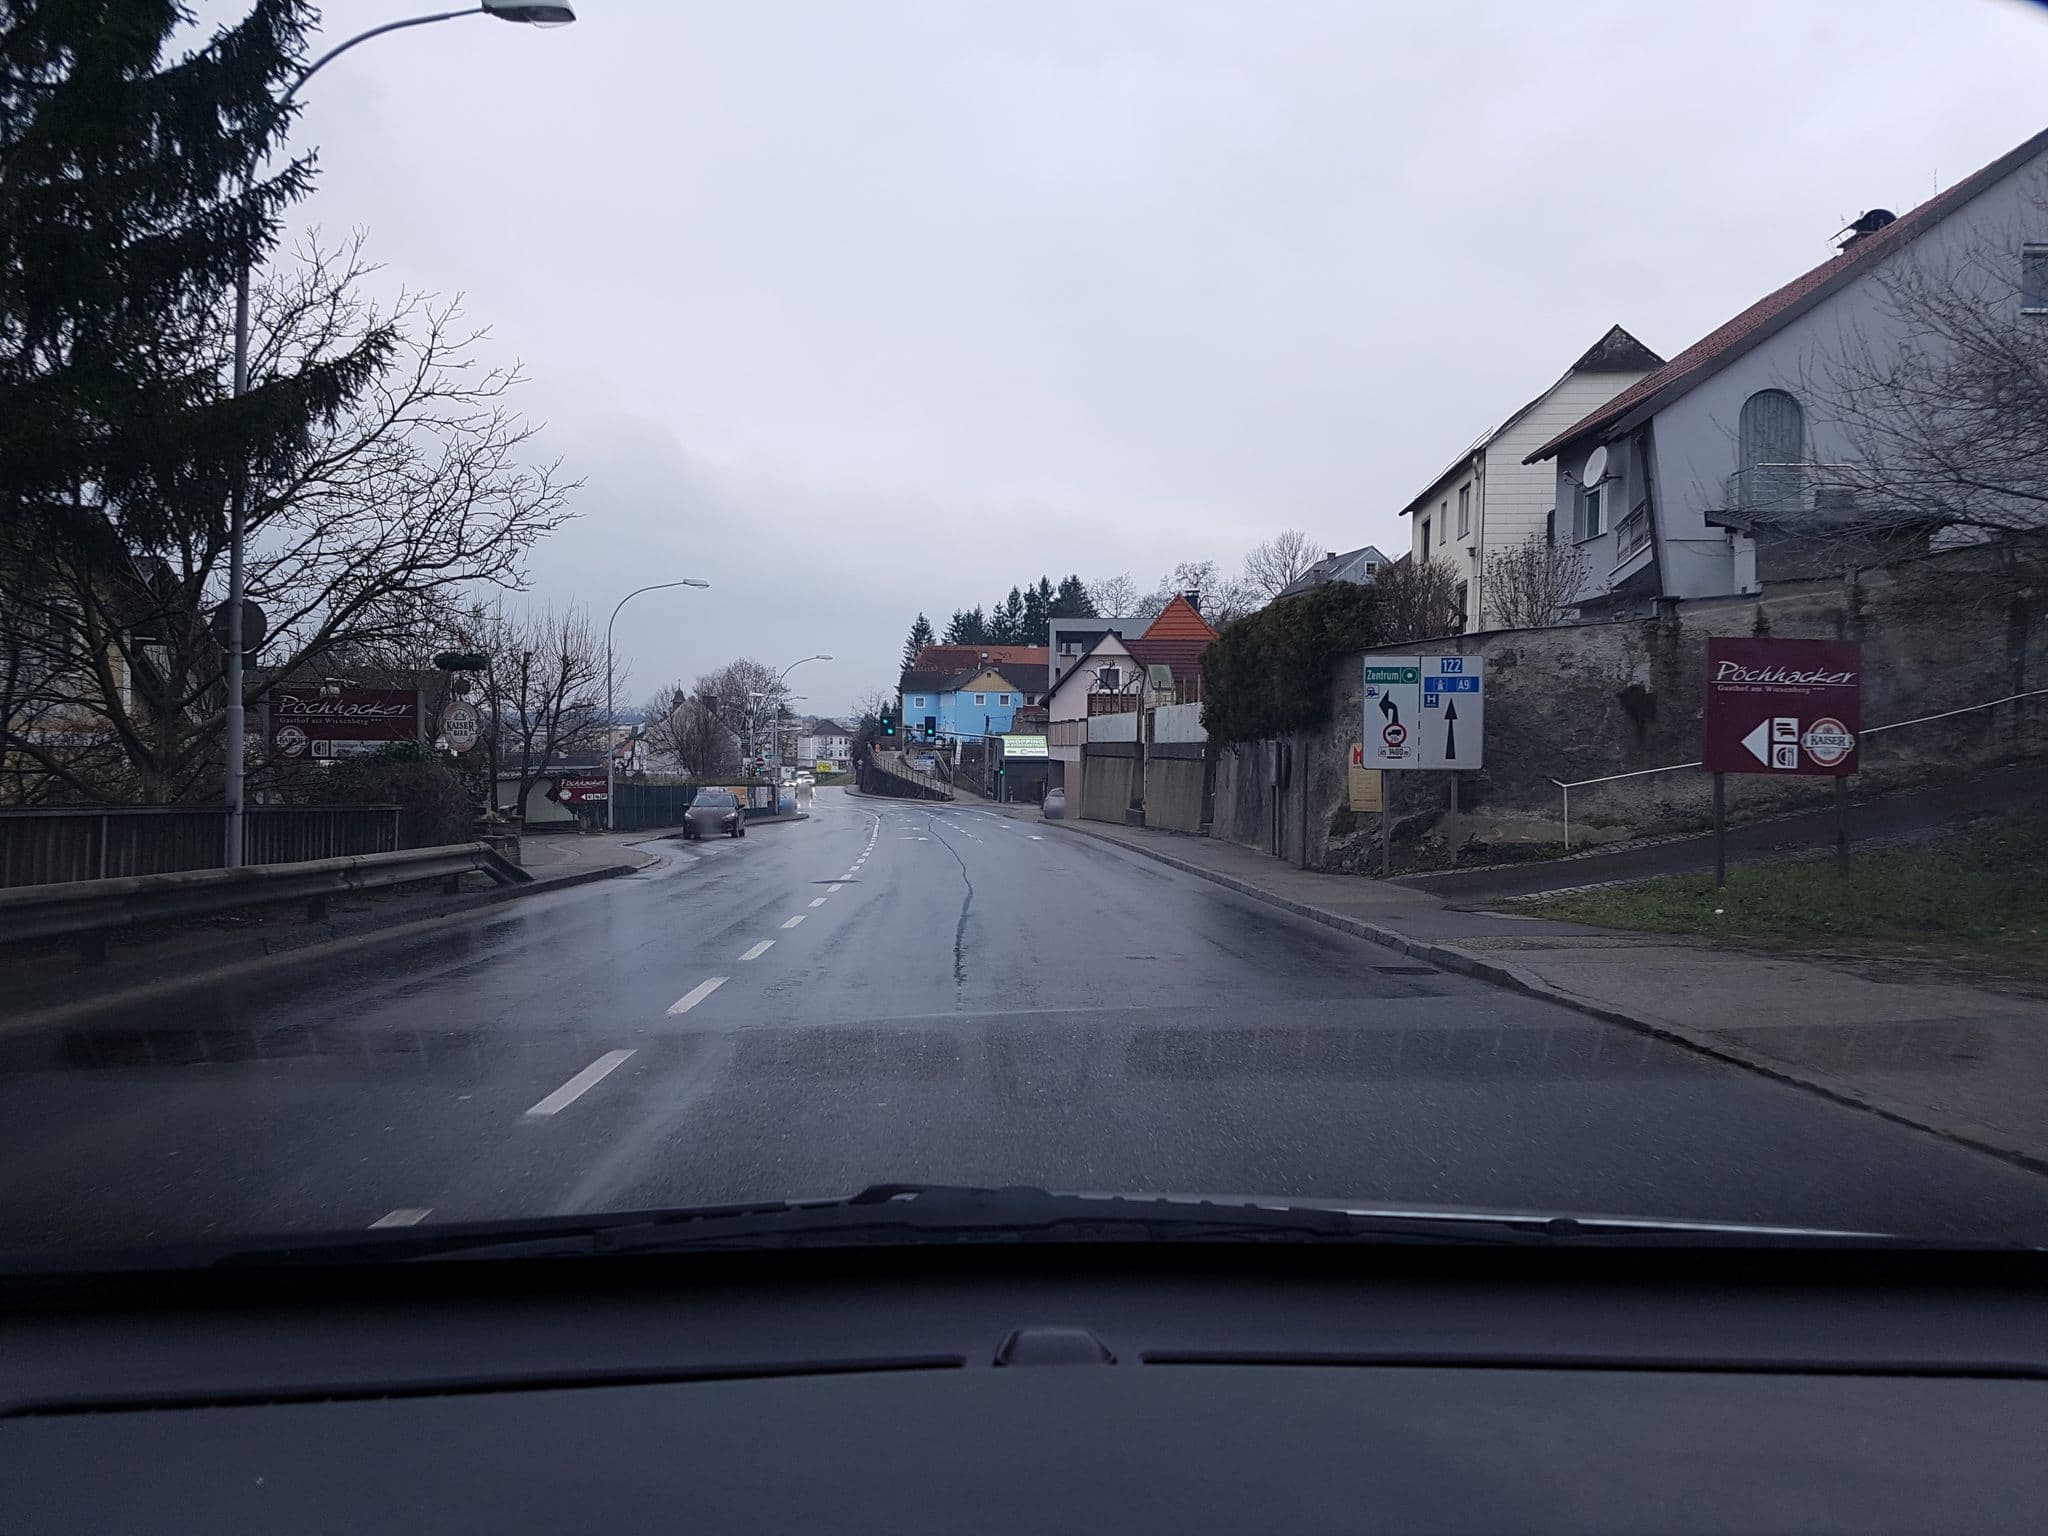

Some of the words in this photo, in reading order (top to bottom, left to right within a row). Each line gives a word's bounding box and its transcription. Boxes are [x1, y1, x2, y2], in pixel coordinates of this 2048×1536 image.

[1442, 659, 1462, 673] 122
[1716, 660, 1857, 684] Pöchhacker
[1366, 669, 1399, 681] Zentrum
[1457, 679, 1470, 690] A9
[446, 720, 475, 732] KAISER
[1810, 735, 1845, 746] KAISER
